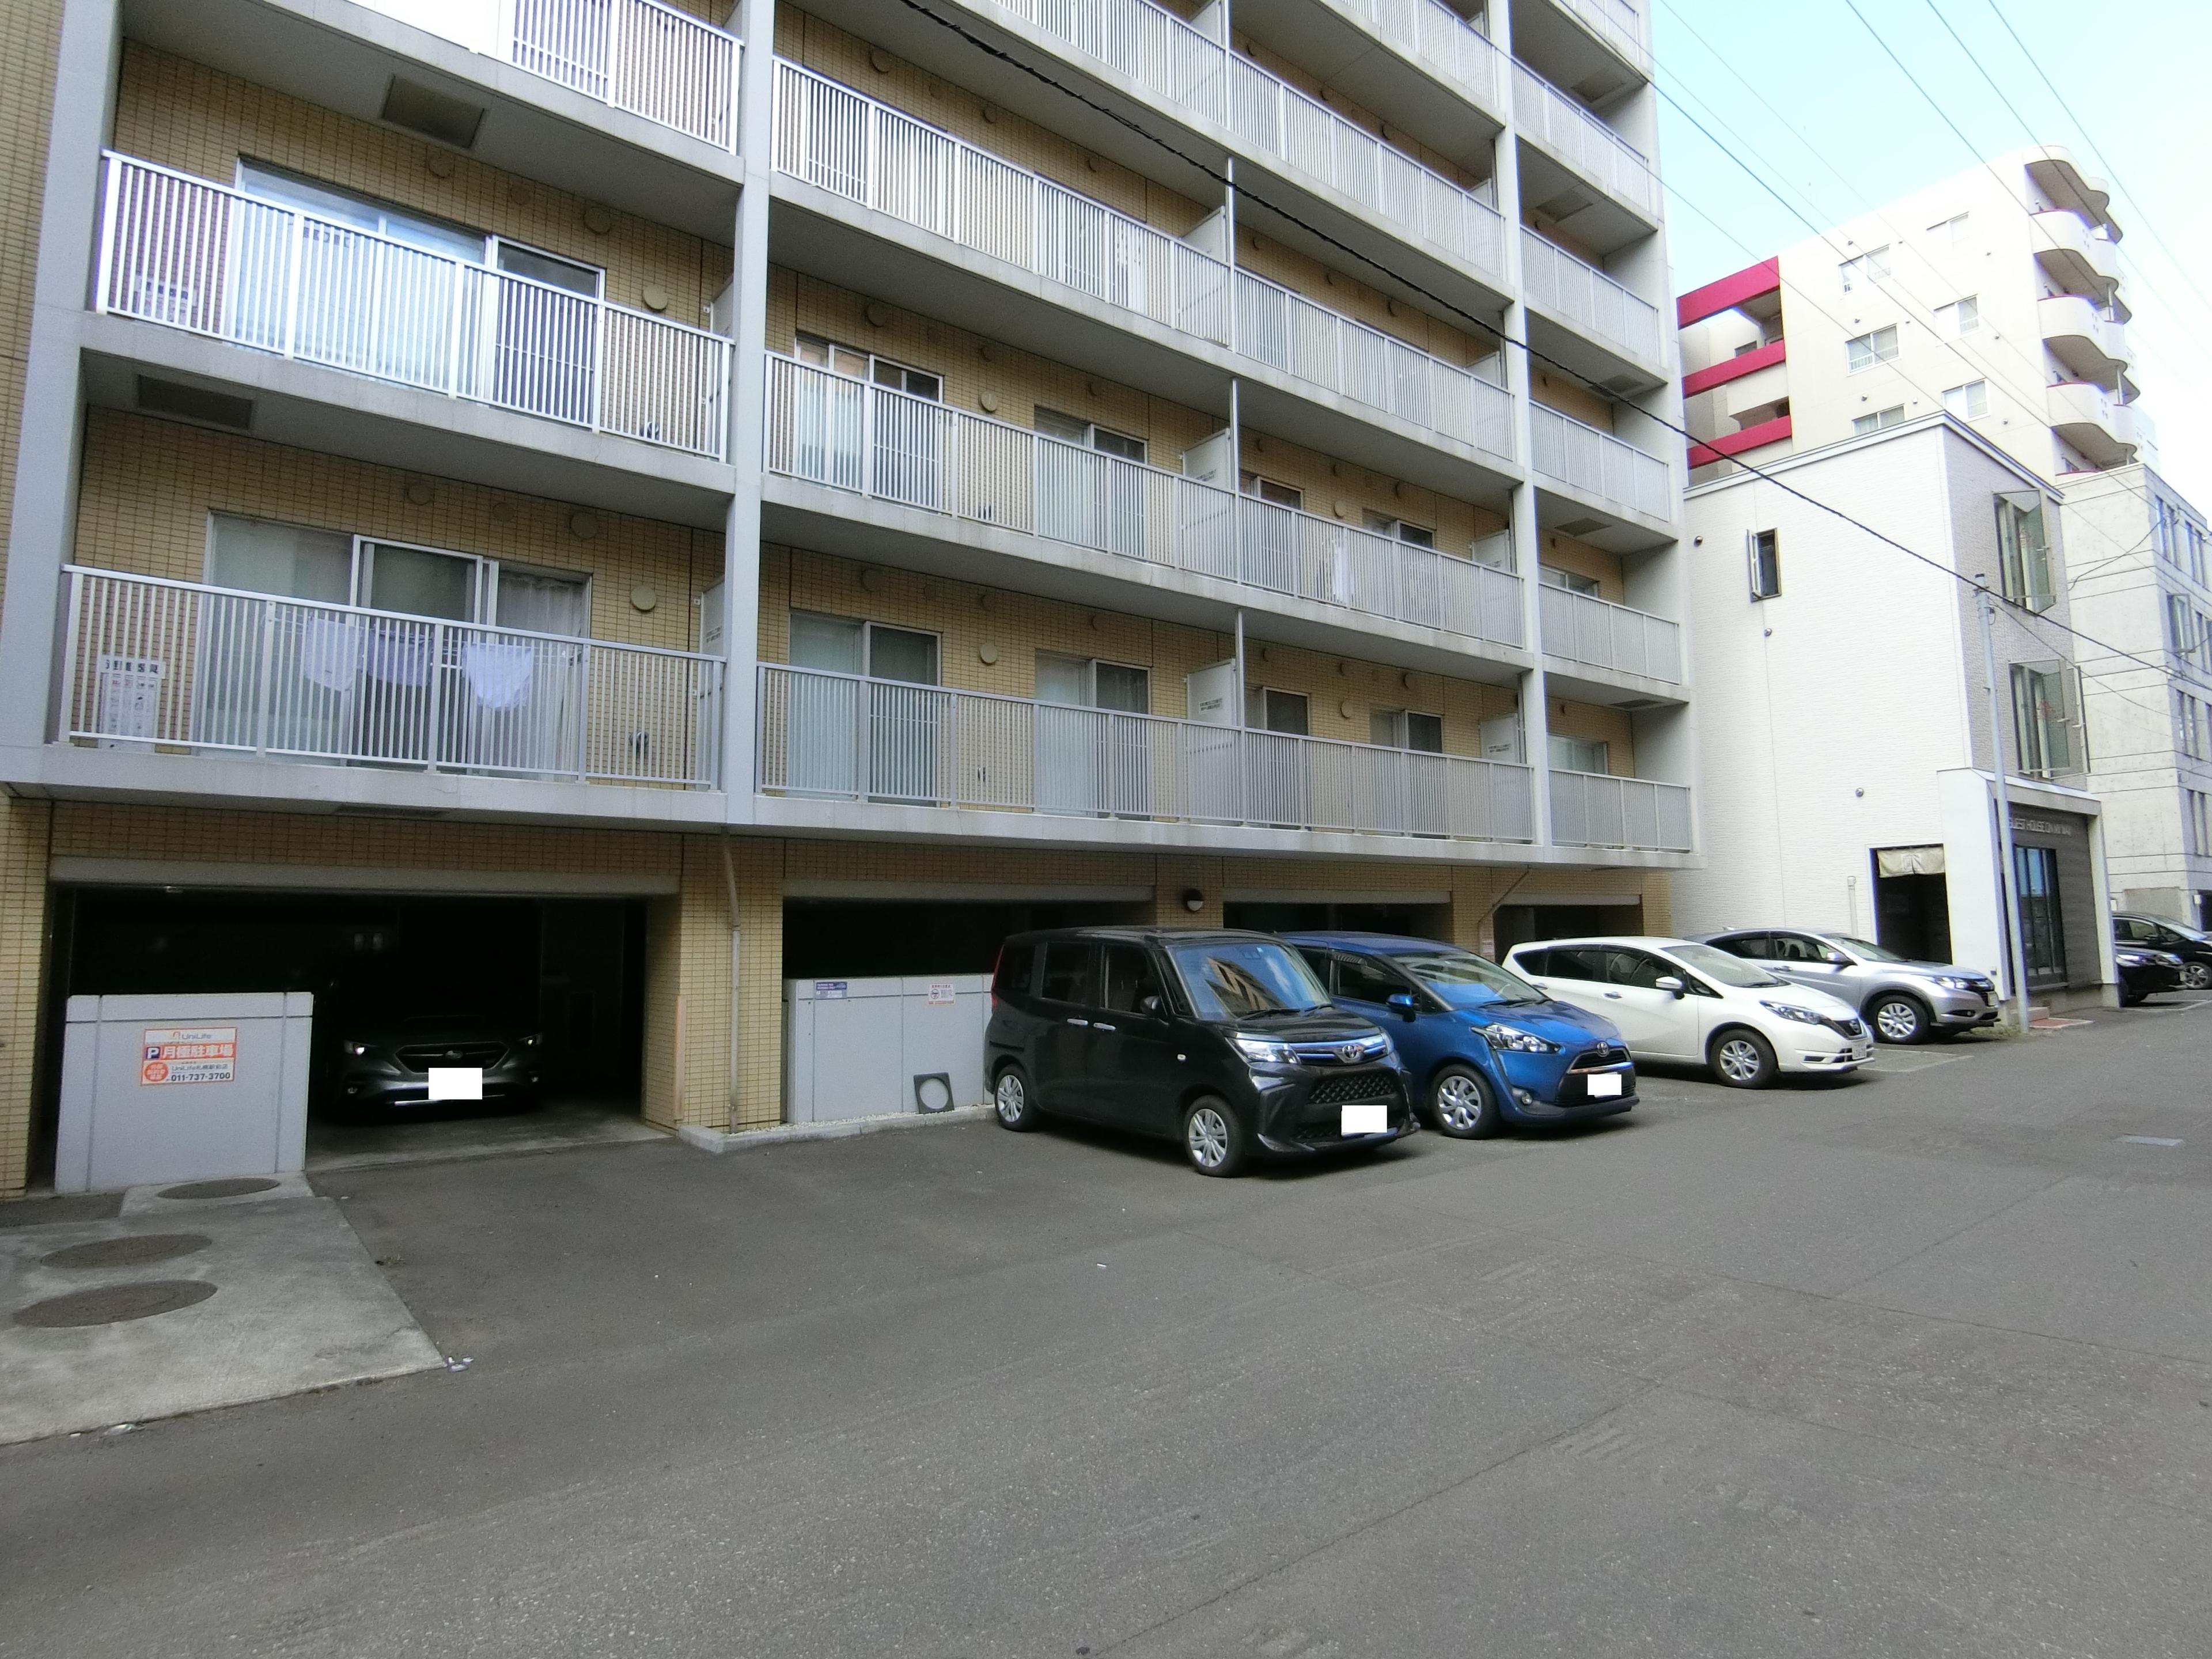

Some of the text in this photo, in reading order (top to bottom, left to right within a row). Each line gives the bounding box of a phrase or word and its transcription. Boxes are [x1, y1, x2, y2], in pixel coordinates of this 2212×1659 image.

[147, 1047, 160, 1059] P
[163, 1044, 233, 1059] 月極駐車場
[171, 1072, 230, 1081] 011-737-3700
